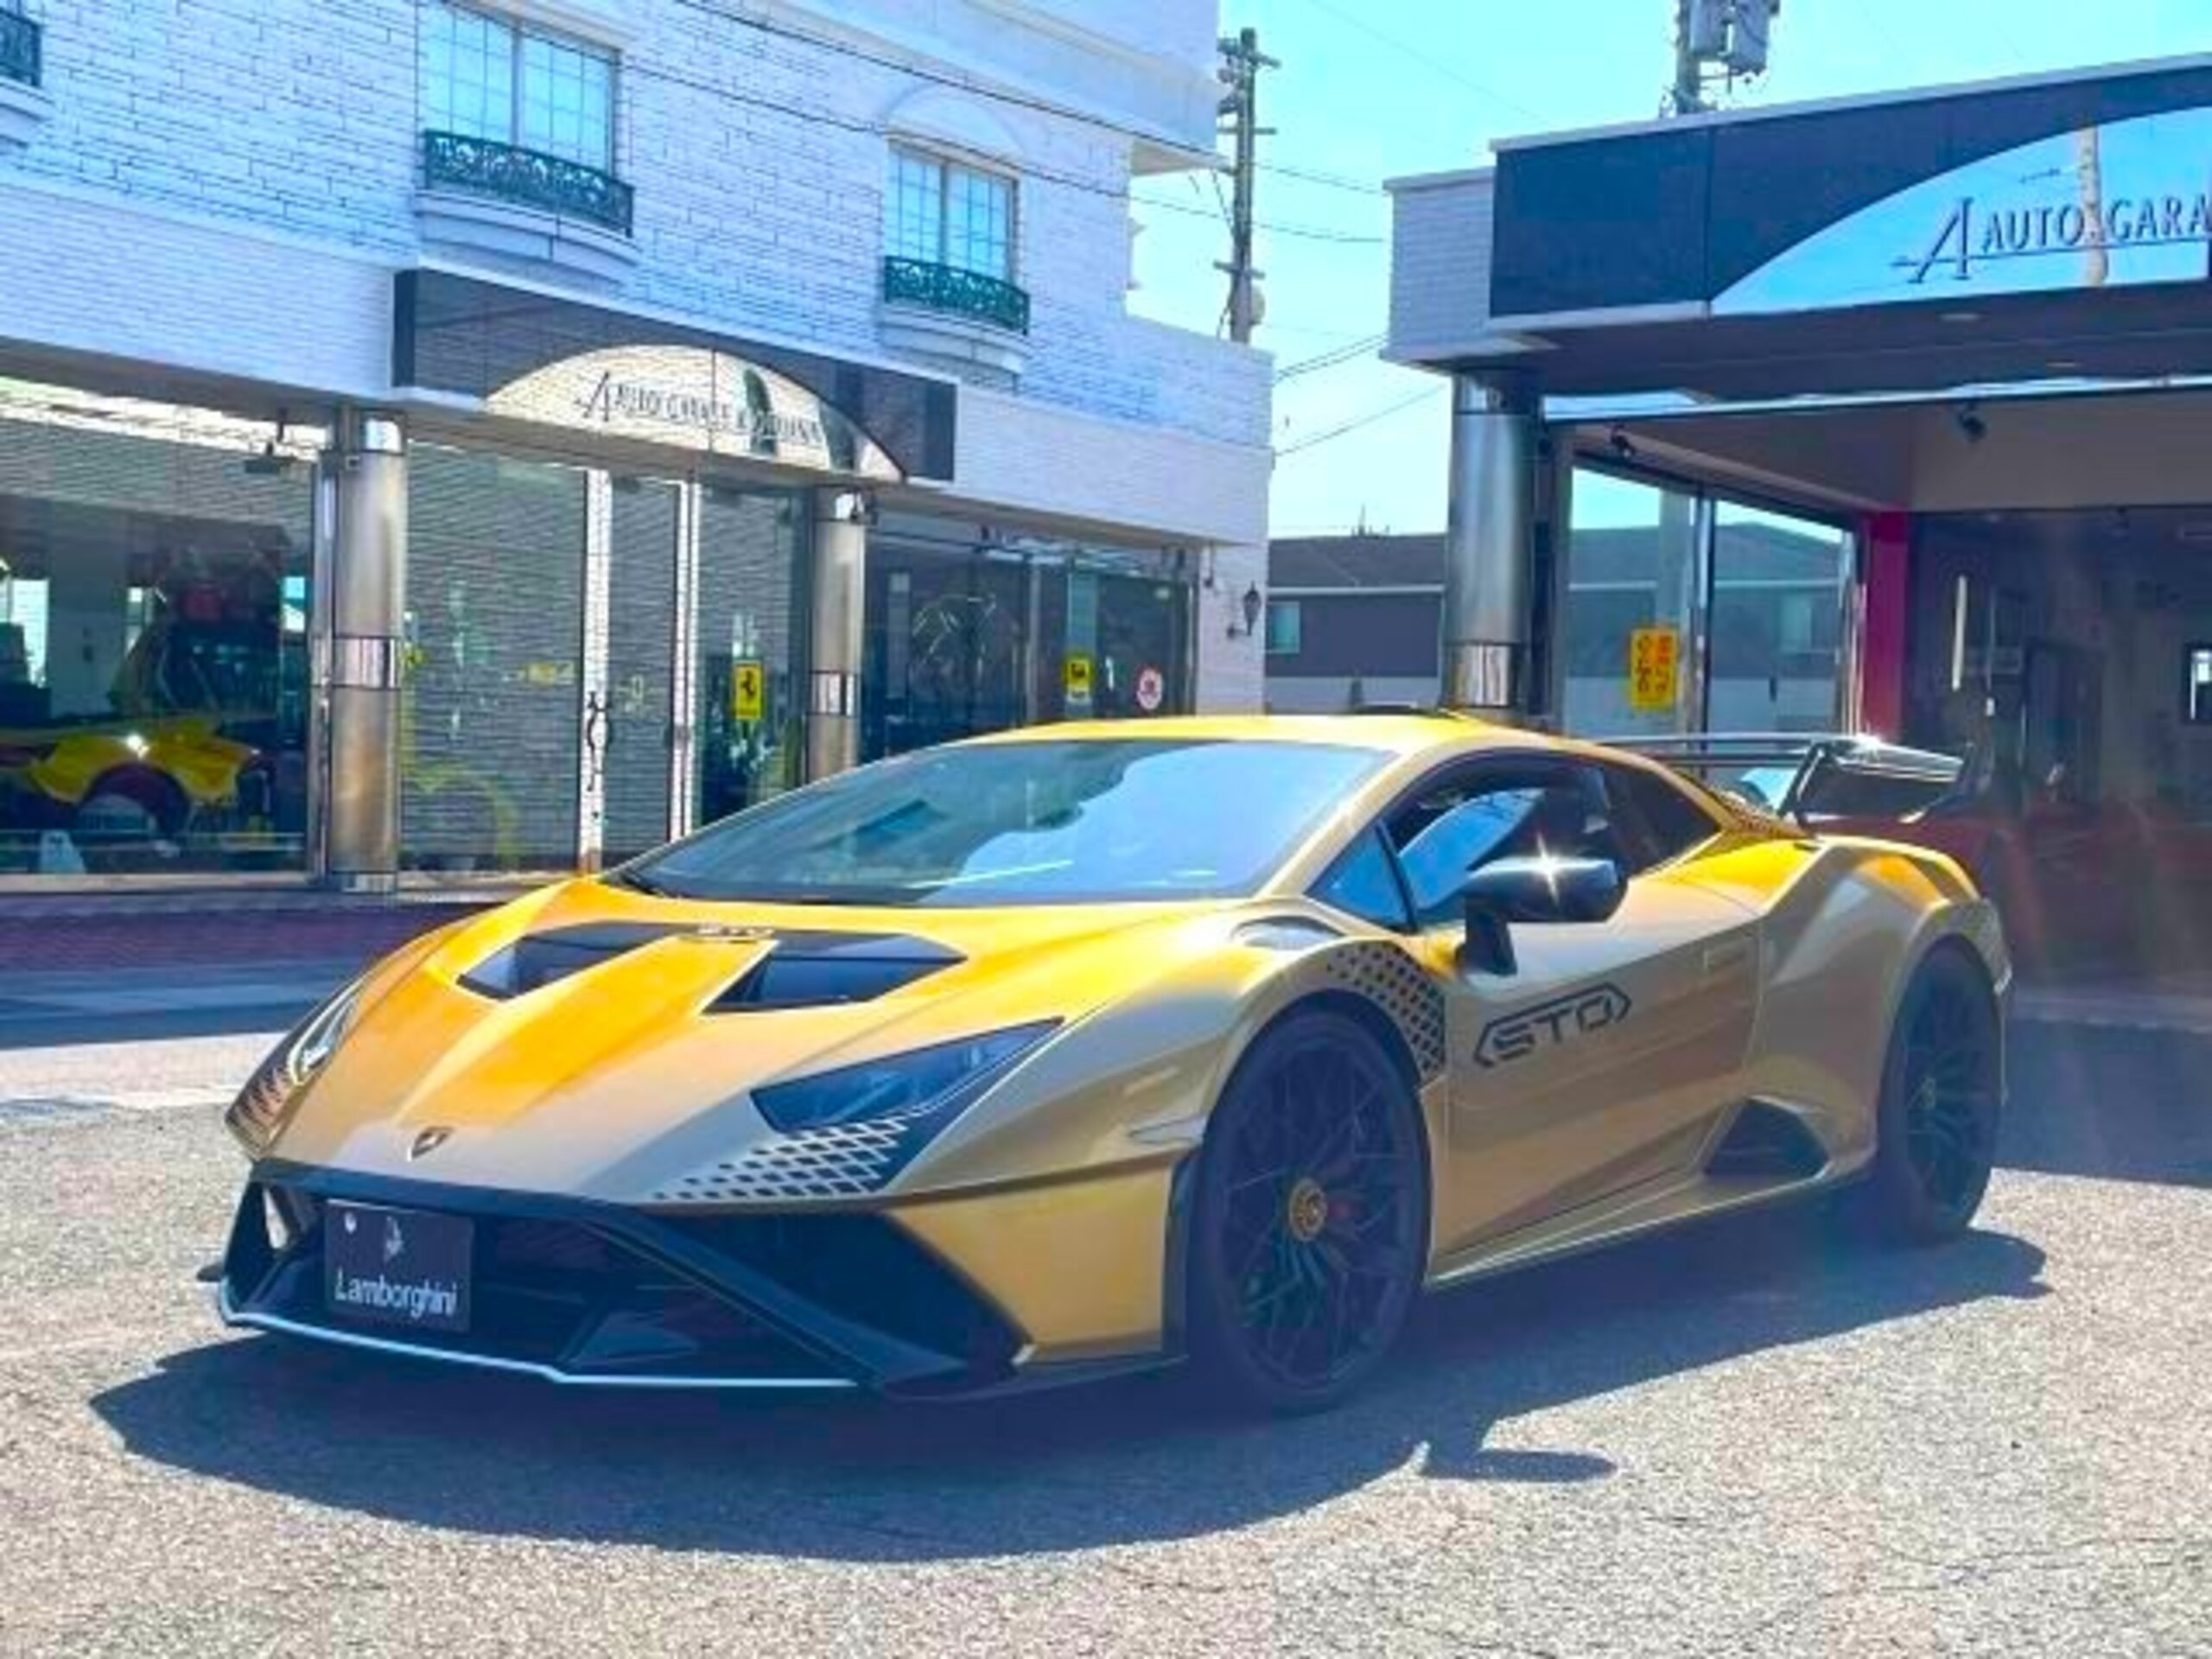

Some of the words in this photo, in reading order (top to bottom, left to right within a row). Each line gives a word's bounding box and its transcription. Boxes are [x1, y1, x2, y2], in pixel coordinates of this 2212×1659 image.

[1982, 205, 2086, 253] AUTO
[1491, 994, 1615, 1061] STO
[334, 1268, 457, 1319] Lamborghini
